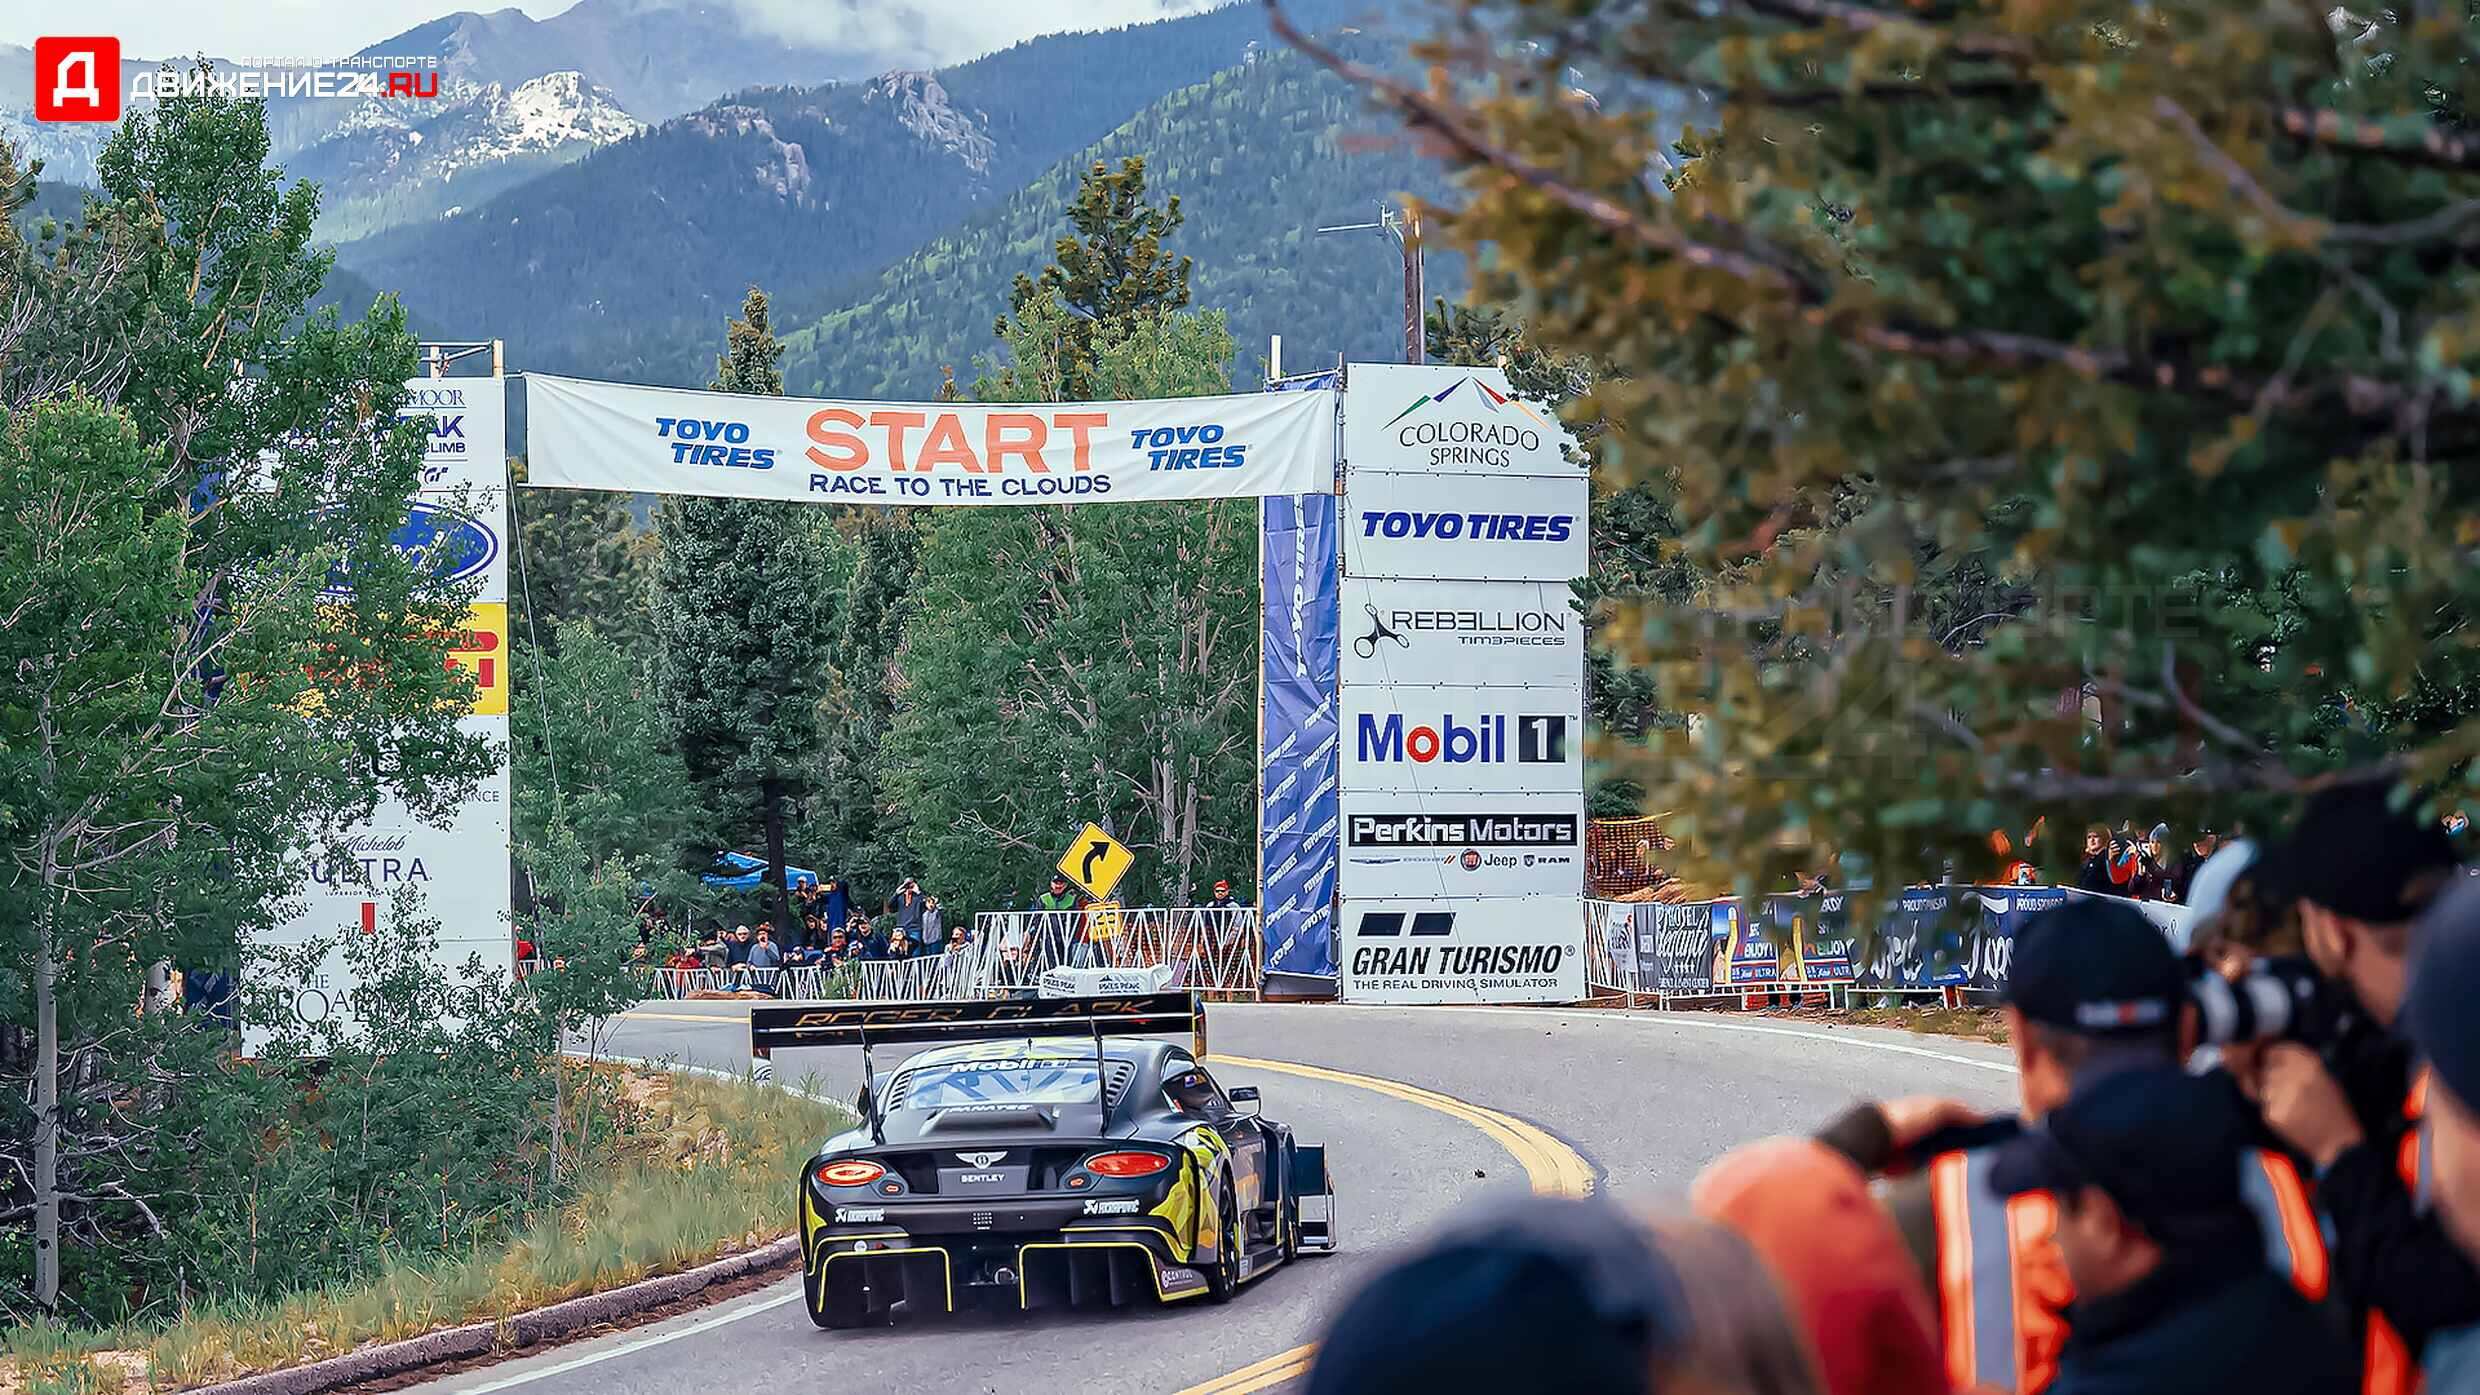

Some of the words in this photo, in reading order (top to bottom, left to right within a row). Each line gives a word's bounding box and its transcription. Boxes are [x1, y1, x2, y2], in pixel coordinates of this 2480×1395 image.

[656, 417, 749, 443] TOYO
[805, 408, 1108, 473] START
[1131, 424, 1224, 449] TOYO
[1399, 421, 1540, 452] COLORADO
[425, 443, 465, 453] LIMB
[671, 442, 775, 470] TIRES
[1148, 445, 1247, 471] TIRES
[1430, 447, 1510, 468] SPRINGS
[810, 473, 886, 494] RACE
[894, 477, 931, 496] TO
[939, 477, 992, 496] THE
[1002, 475, 1112, 496] CLOUDS
[1362, 511, 1464, 538] TOYO
[1467, 512, 1574, 541] TIRES
[1391, 610, 1565, 631] REBELLION
[1357, 713, 1505, 762] Mobil
[1353, 817, 1465, 842] Perkins
[1470, 818, 1571, 841] Motors
[311, 858, 429, 884] ULTRA
[1485, 853, 1517, 868] Jeep
[1352, 946, 1431, 975] GRAN
[1439, 945, 1562, 975] TURISMO
[1354, 980, 1379, 989] THE
[1383, 980, 1417, 989] REAL
[1422, 979, 1475, 989] DRIVING
[1480, 978, 1557, 989] SIMULATOR
[961, 1174, 1005, 1183] BENTLEY
